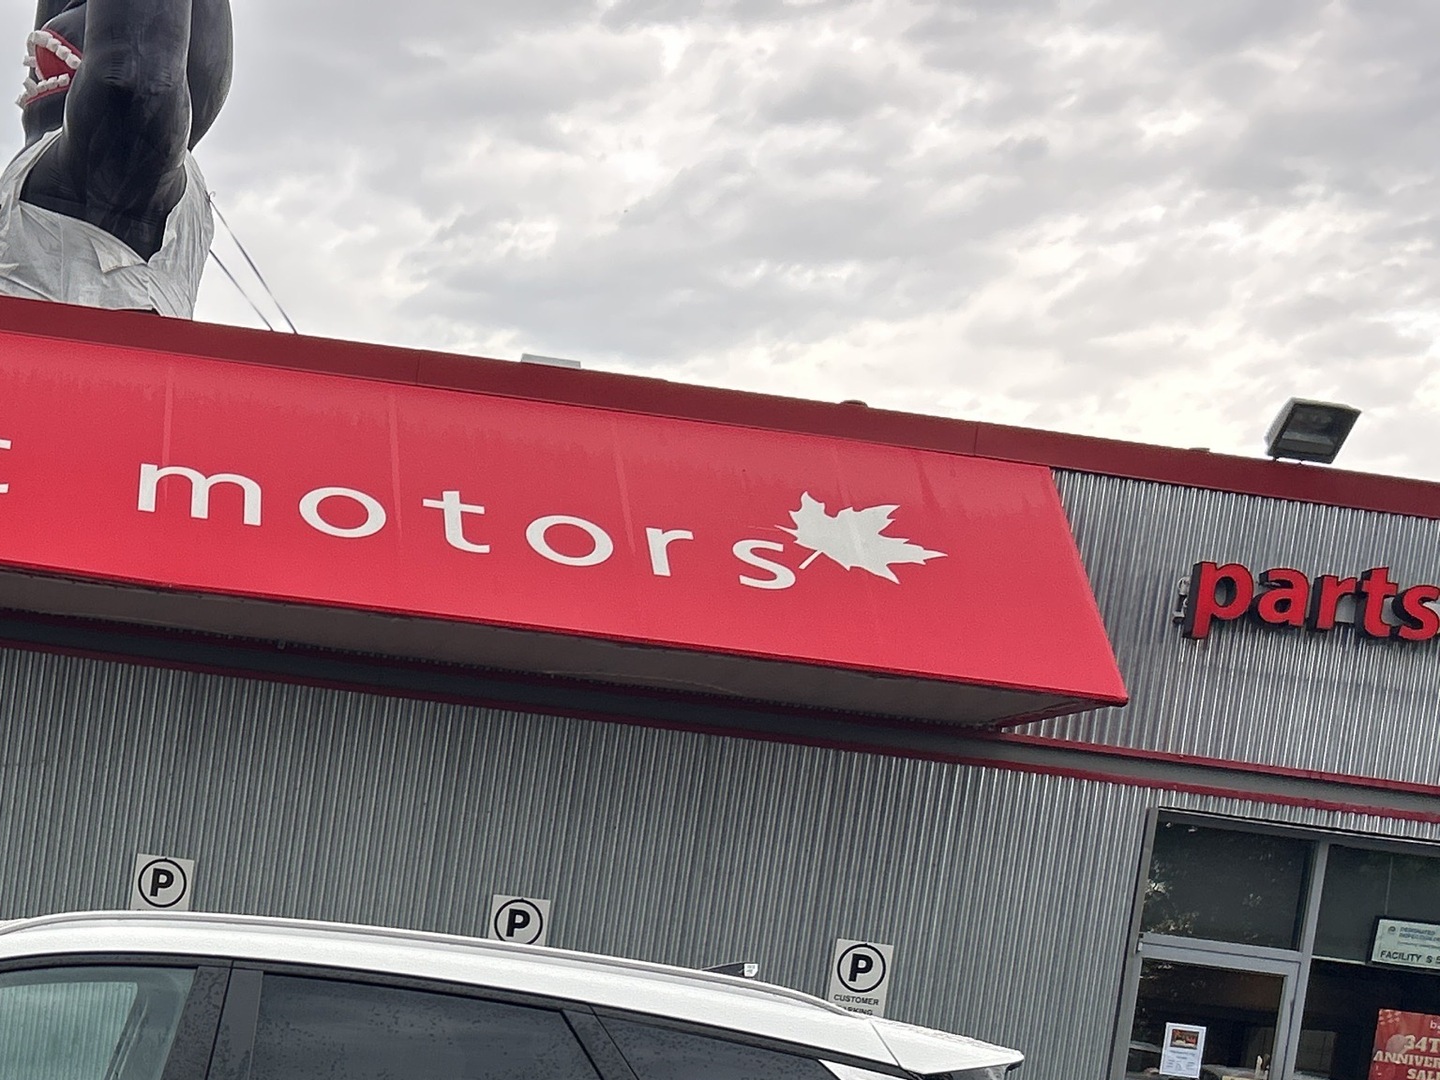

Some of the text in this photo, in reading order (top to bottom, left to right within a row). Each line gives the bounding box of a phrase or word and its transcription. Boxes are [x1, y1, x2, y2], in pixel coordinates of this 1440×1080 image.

[137, 462, 796, 590] motors
[1182, 561, 1440, 641] parts
[149, 867, 175, 897] P
[505, 908, 531, 938] P
[848, 953, 874, 982] P
[1380, 949, 1422, 962] FACILITY
[833, 993, 879, 1006] CUSTOMER
[836, 1004, 873, 1016] RKING
